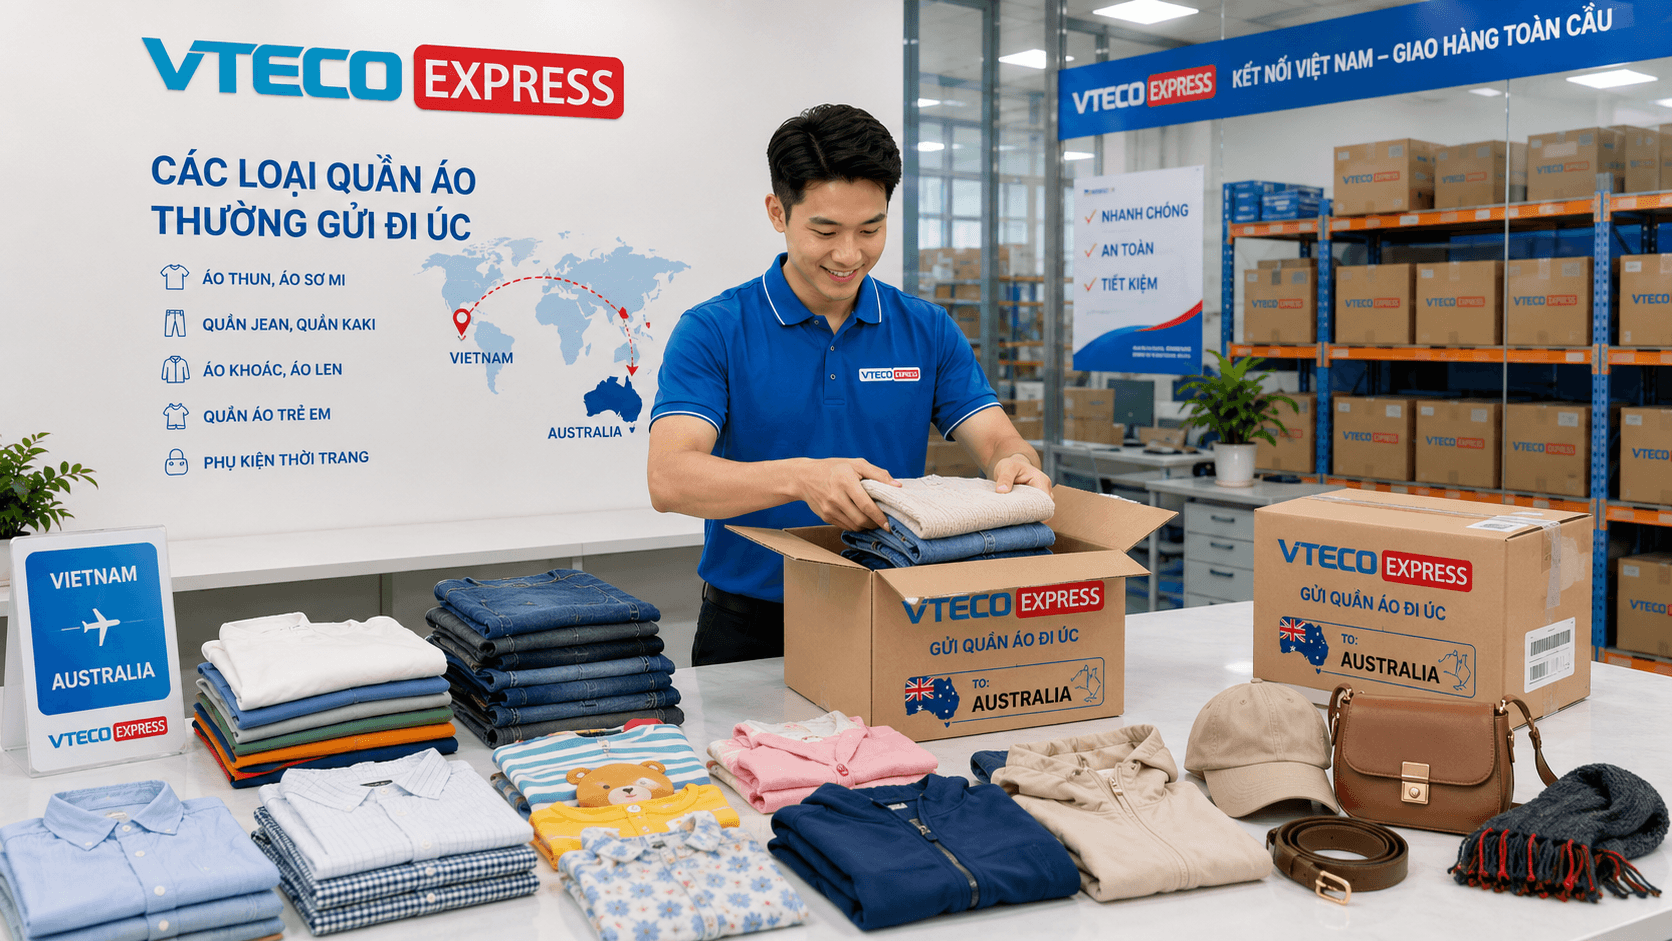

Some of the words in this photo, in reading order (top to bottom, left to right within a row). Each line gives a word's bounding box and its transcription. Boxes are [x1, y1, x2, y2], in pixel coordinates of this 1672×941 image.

[1072, 81, 1145, 114] VTECO
[1150, 72, 1212, 101] EXPRESS
[1232, 61, 1261, 88] KẾT
[1264, 55, 1291, 83] NỐI
[1295, 52, 1330, 81] VIỆT
[1334, 48, 1373, 72] NAM
[1393, 38, 1438, 63] GIAO
[1443, 27, 1499, 56] HÀNG
[1503, 15, 1560, 46] TOÀN
[1566, 2, 1613, 36] CẦU
[142, 37, 402, 101] VTECO
[424, 59, 615, 107] EXPRESS
[151, 149, 228, 187] CÁC
[239, 160, 316, 197] LOẠI
[327, 154, 422, 193] QUẦN
[431, 159, 477, 195] ÁO
[150, 200, 307, 238] THƯỜNG
[317, 202, 374, 240] GỬI
[385, 211, 416, 240] ĐI
[427, 204, 471, 240] ÚC
[1102, 207, 1143, 222] NHANH
[1146, 201, 1189, 219] CHÓNG
[1101, 243, 1118, 257] AN
[1121, 239, 1154, 256] TOÀN
[202, 269, 224, 285] ÁO
[229, 272, 275, 287] THUN,
[279, 269, 300, 286] ÁO
[304, 273, 325, 286] SƠ
[329, 274, 345, 286] MI
[1101, 274, 1125, 291] TIẾT
[1129, 274, 1158, 293] KIỆM
[1345, 299, 1373, 308] VTECO
[1426, 298, 1456, 307] VTECO
[1514, 296, 1546, 306] VTECO
[1632, 293, 1670, 304] VTECO
[250, 318, 293, 332] JEAN,
[342, 318, 376, 330] KAKI
[450, 352, 513, 364] VIETNAM
[203, 361, 225, 377] ÁO
[229, 361, 286, 378] KHOÁC,
[290, 360, 311, 375] ÁO
[315, 363, 342, 375] LEN
[861, 371, 892, 379] VTECO
[252, 406, 273, 421] ÁO
[277, 404, 305, 420] TRẺ
[310, 408, 331, 420] EM
[548, 426, 622, 439] AUSTRALIA
[1343, 431, 1372, 442] VTECO
[1426, 436, 1456, 446] VTECO
[1513, 441, 1545, 452] VTECO
[1632, 448, 1669, 460] VTECO
[204, 456, 236, 471] PHỤ
[241, 452, 274, 469] KIỆN
[279, 450, 314, 465] THỜI
[318, 451, 369, 464] TRANG
[1278, 539, 1377, 575] VTECO
[1386, 556, 1467, 586] EXPRESS
[50, 565, 137, 589] VIETNAM
[902, 592, 1011, 624] VTECO
[1021, 587, 1100, 611] EXPRESS
[1300, 584, 1325, 602] GỬI
[1330, 589, 1373, 610] QUẦN
[1378, 594, 1400, 614] ÁO
[1404, 601, 1419, 617] ĐI
[1424, 600, 1446, 621] ÚC
[1630, 599, 1667, 614] VTECO
[930, 636, 957, 656] GỬI
[963, 631, 1008, 653] QUẦN
[1012, 630, 1034, 648] ÁO
[1039, 631, 1053, 645] ĐI
[1058, 626, 1079, 643] ÚC
[1341, 633, 1358, 645] TO:
[52, 662, 155, 690] AUSTRALIA
[1341, 651, 1440, 684] AUSTRALIA
[972, 679, 989, 689] TO:
[972, 686, 1071, 712] AUSTRALIA
[48, 726, 111, 748] VTECO
[116, 720, 165, 738] EXPRESS
